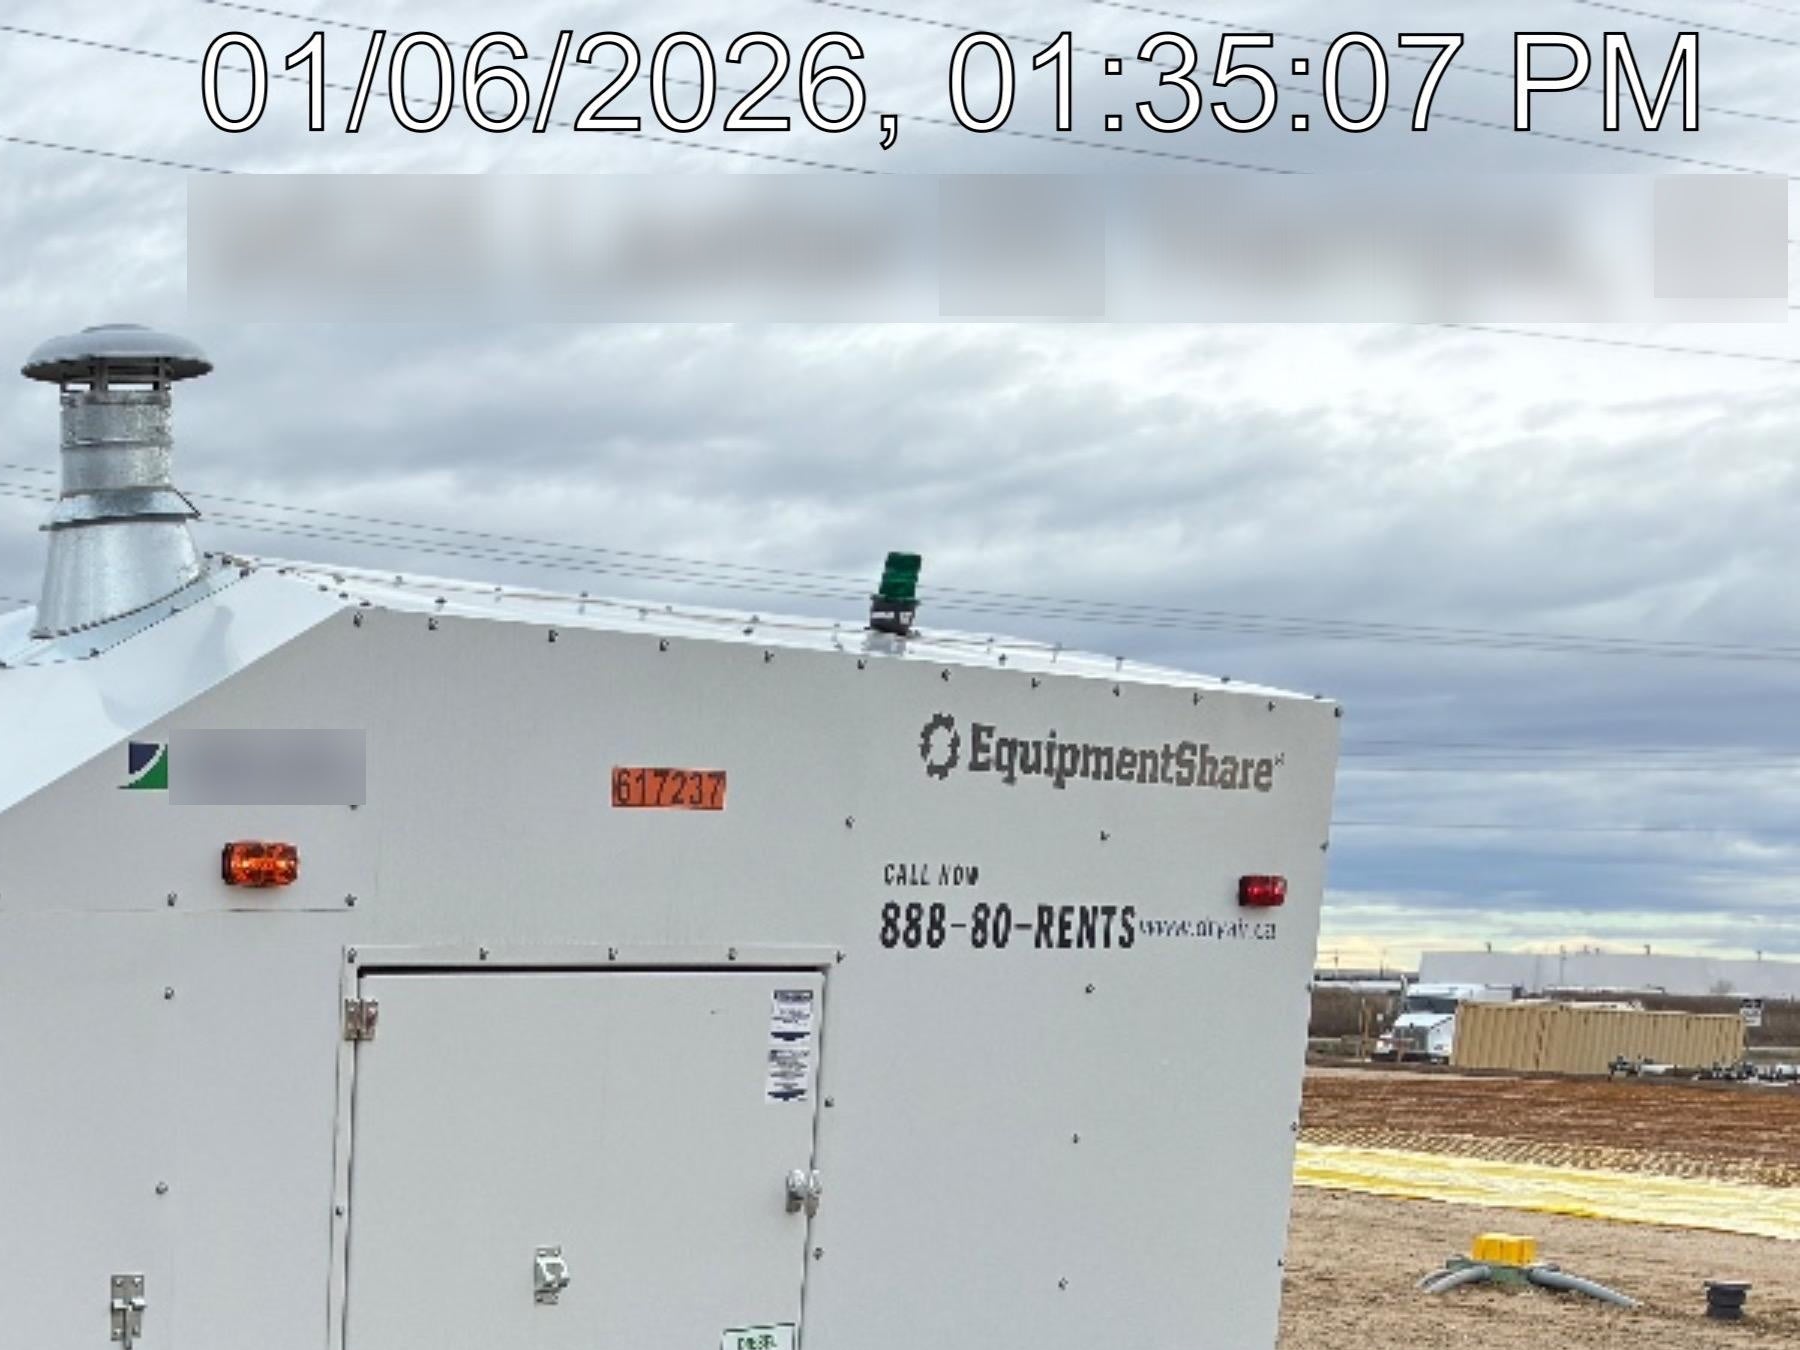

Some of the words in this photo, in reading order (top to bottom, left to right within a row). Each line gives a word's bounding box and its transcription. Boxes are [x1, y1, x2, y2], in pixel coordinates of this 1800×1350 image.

[968, 722, 1273, 793] EquipmentShare
[617, 768, 722, 806] 617237
[884, 863, 930, 886] CALL
[938, 863, 979, 886] NOW
[879, 901, 1136, 949] 888-80-RENTS
